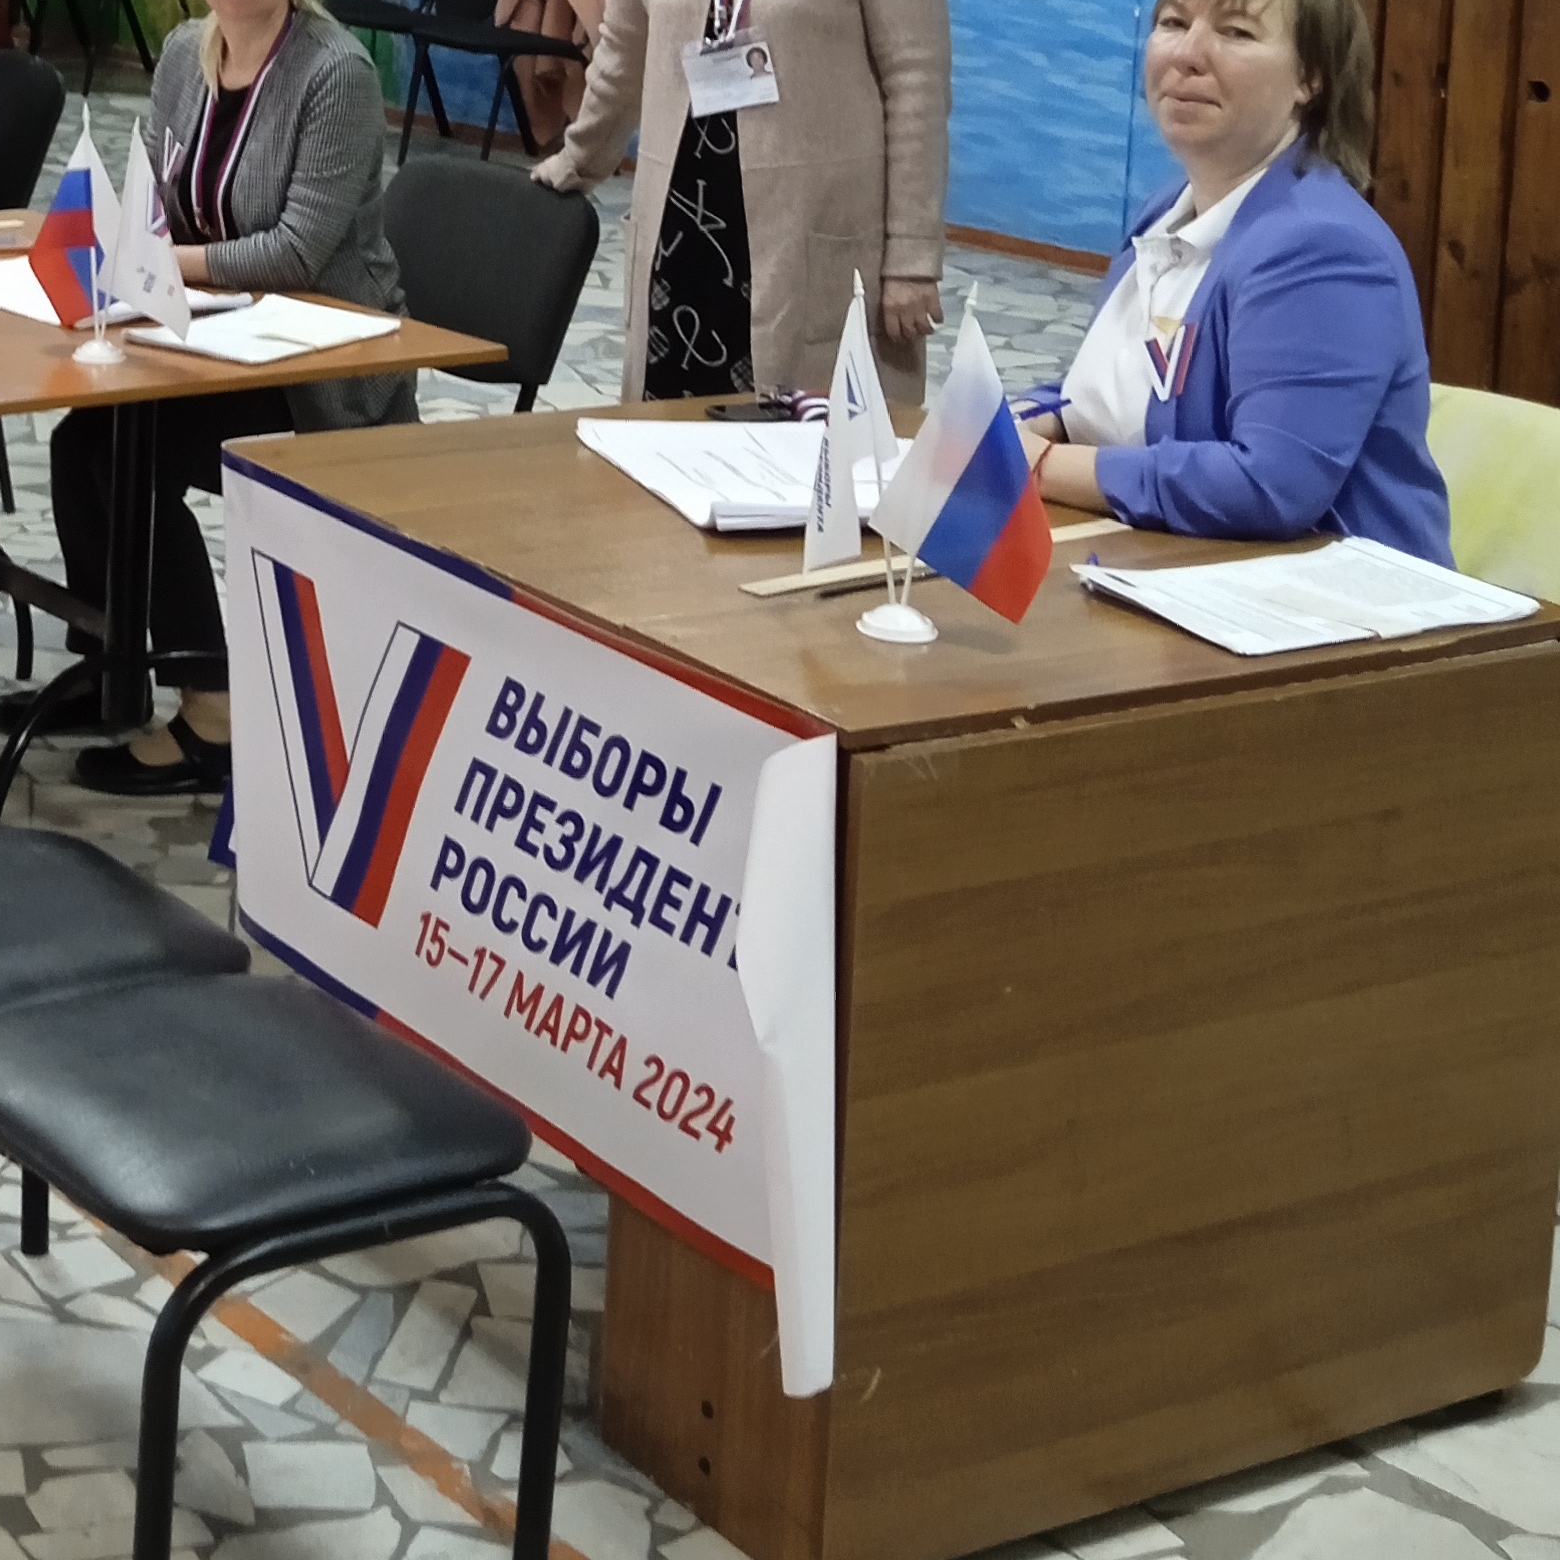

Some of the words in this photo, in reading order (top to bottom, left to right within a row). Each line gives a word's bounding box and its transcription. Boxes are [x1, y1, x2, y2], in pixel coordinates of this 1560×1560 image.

[485, 676, 722, 847] ВЫБОРЫ
[430, 834, 632, 1000] РОССИИ
[454, 757, 740, 971] ПРЕЗИДЕН
[504, 971, 627, 1092] МАРТА
[632, 1054, 737, 1154] 2024
